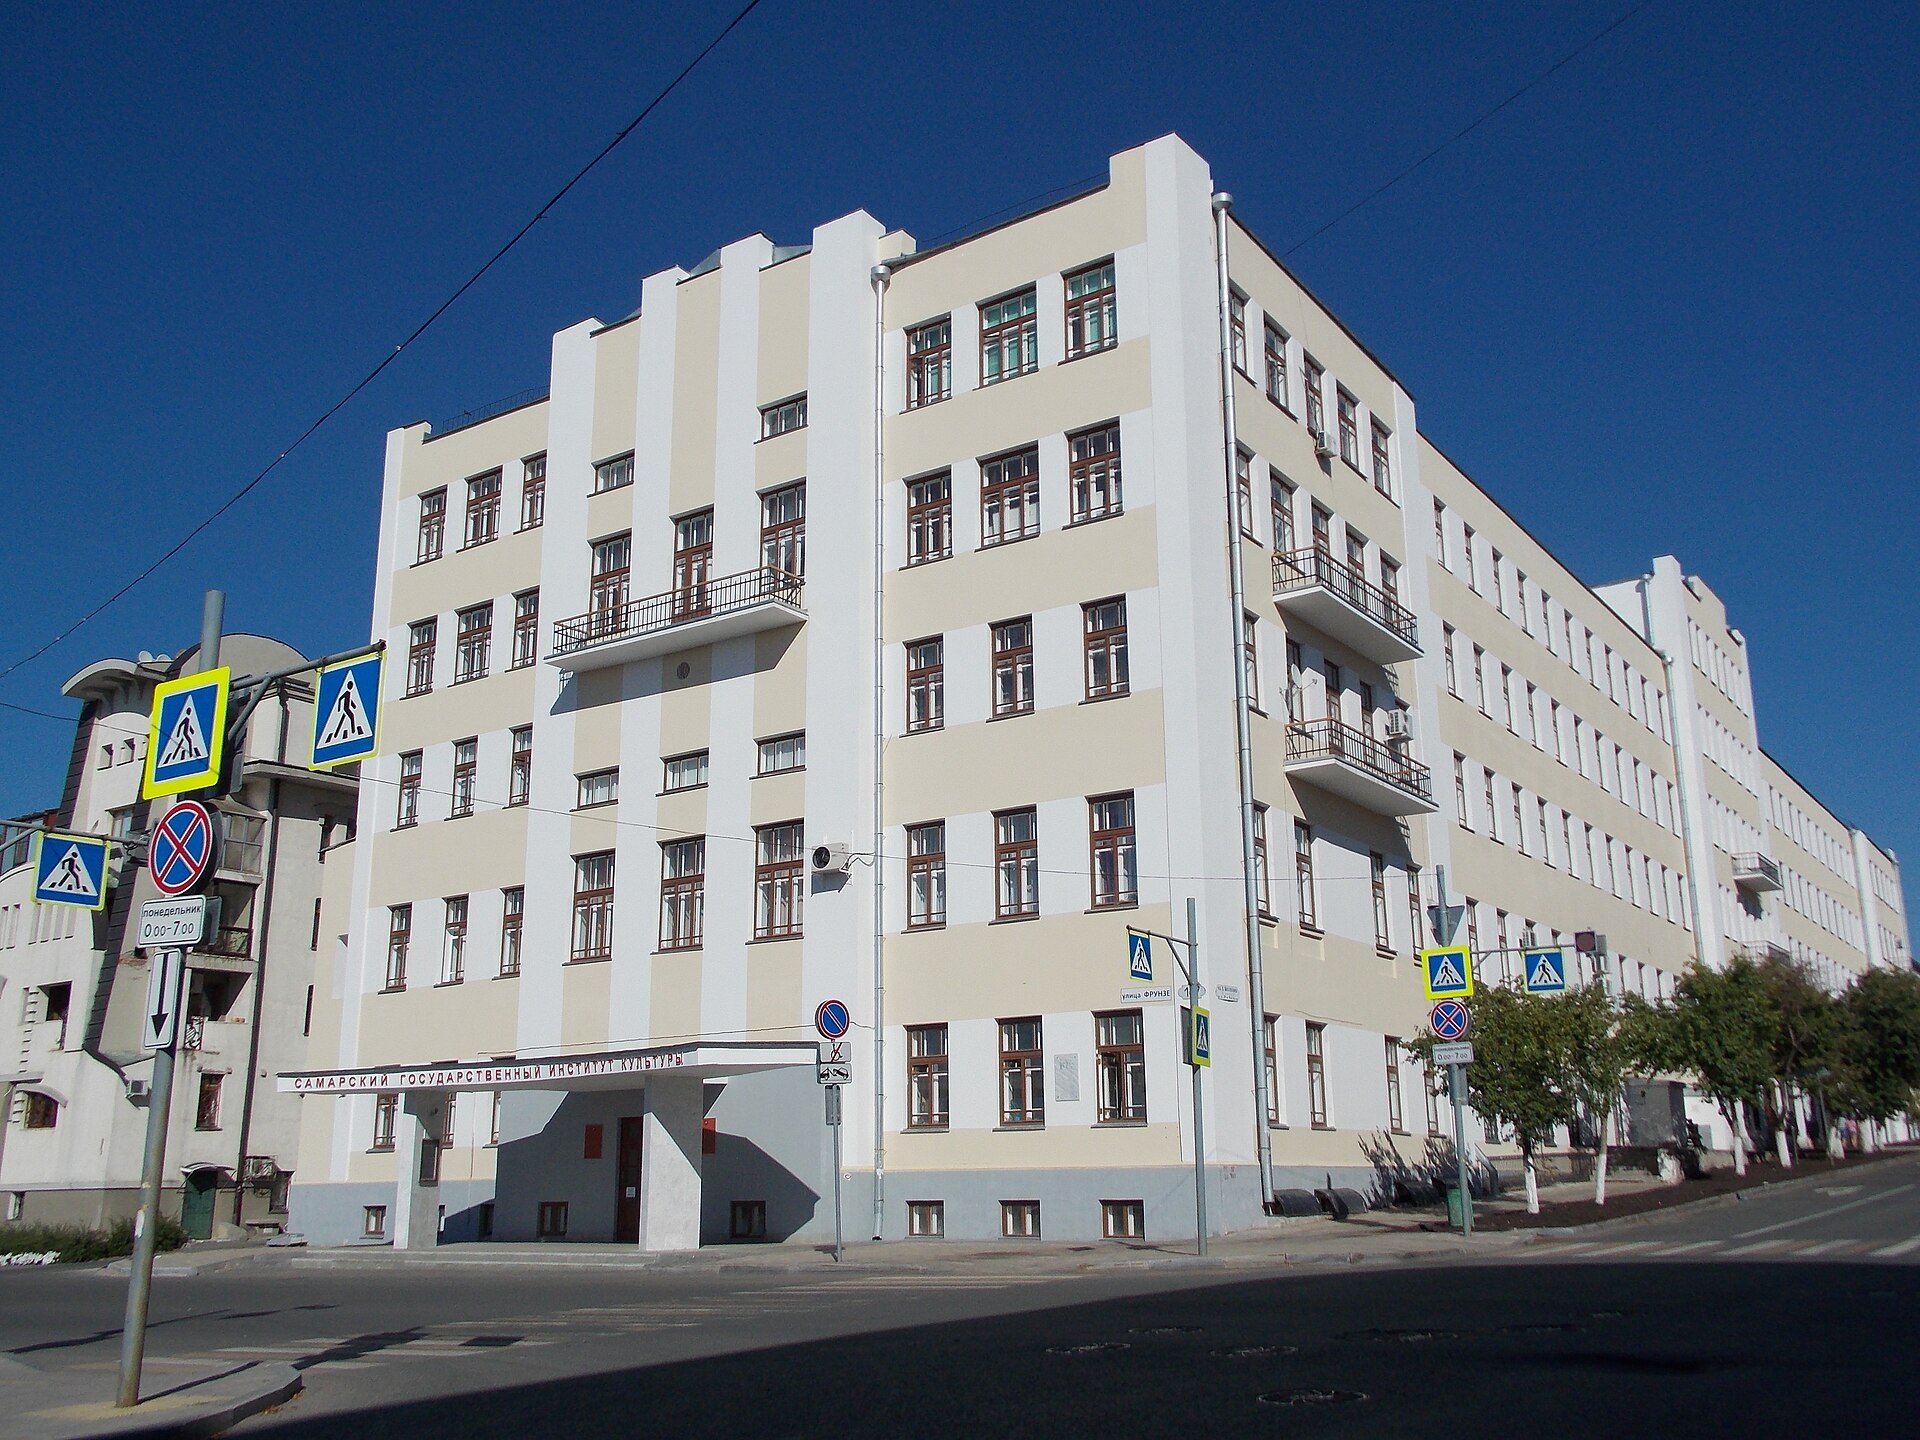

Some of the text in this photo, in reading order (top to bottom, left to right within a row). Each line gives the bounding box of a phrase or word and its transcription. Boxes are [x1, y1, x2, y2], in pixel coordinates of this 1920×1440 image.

[143, 905, 202, 917] понедельник
[1121, 989, 1170, 1000] улица ФРУНЗЕ
[294, 1053, 684, 1089] САМАРСКИЙ ГОСУДАРСТВЕННЫЙ ИНСТИТУТ КУЛЬТУРЫ
